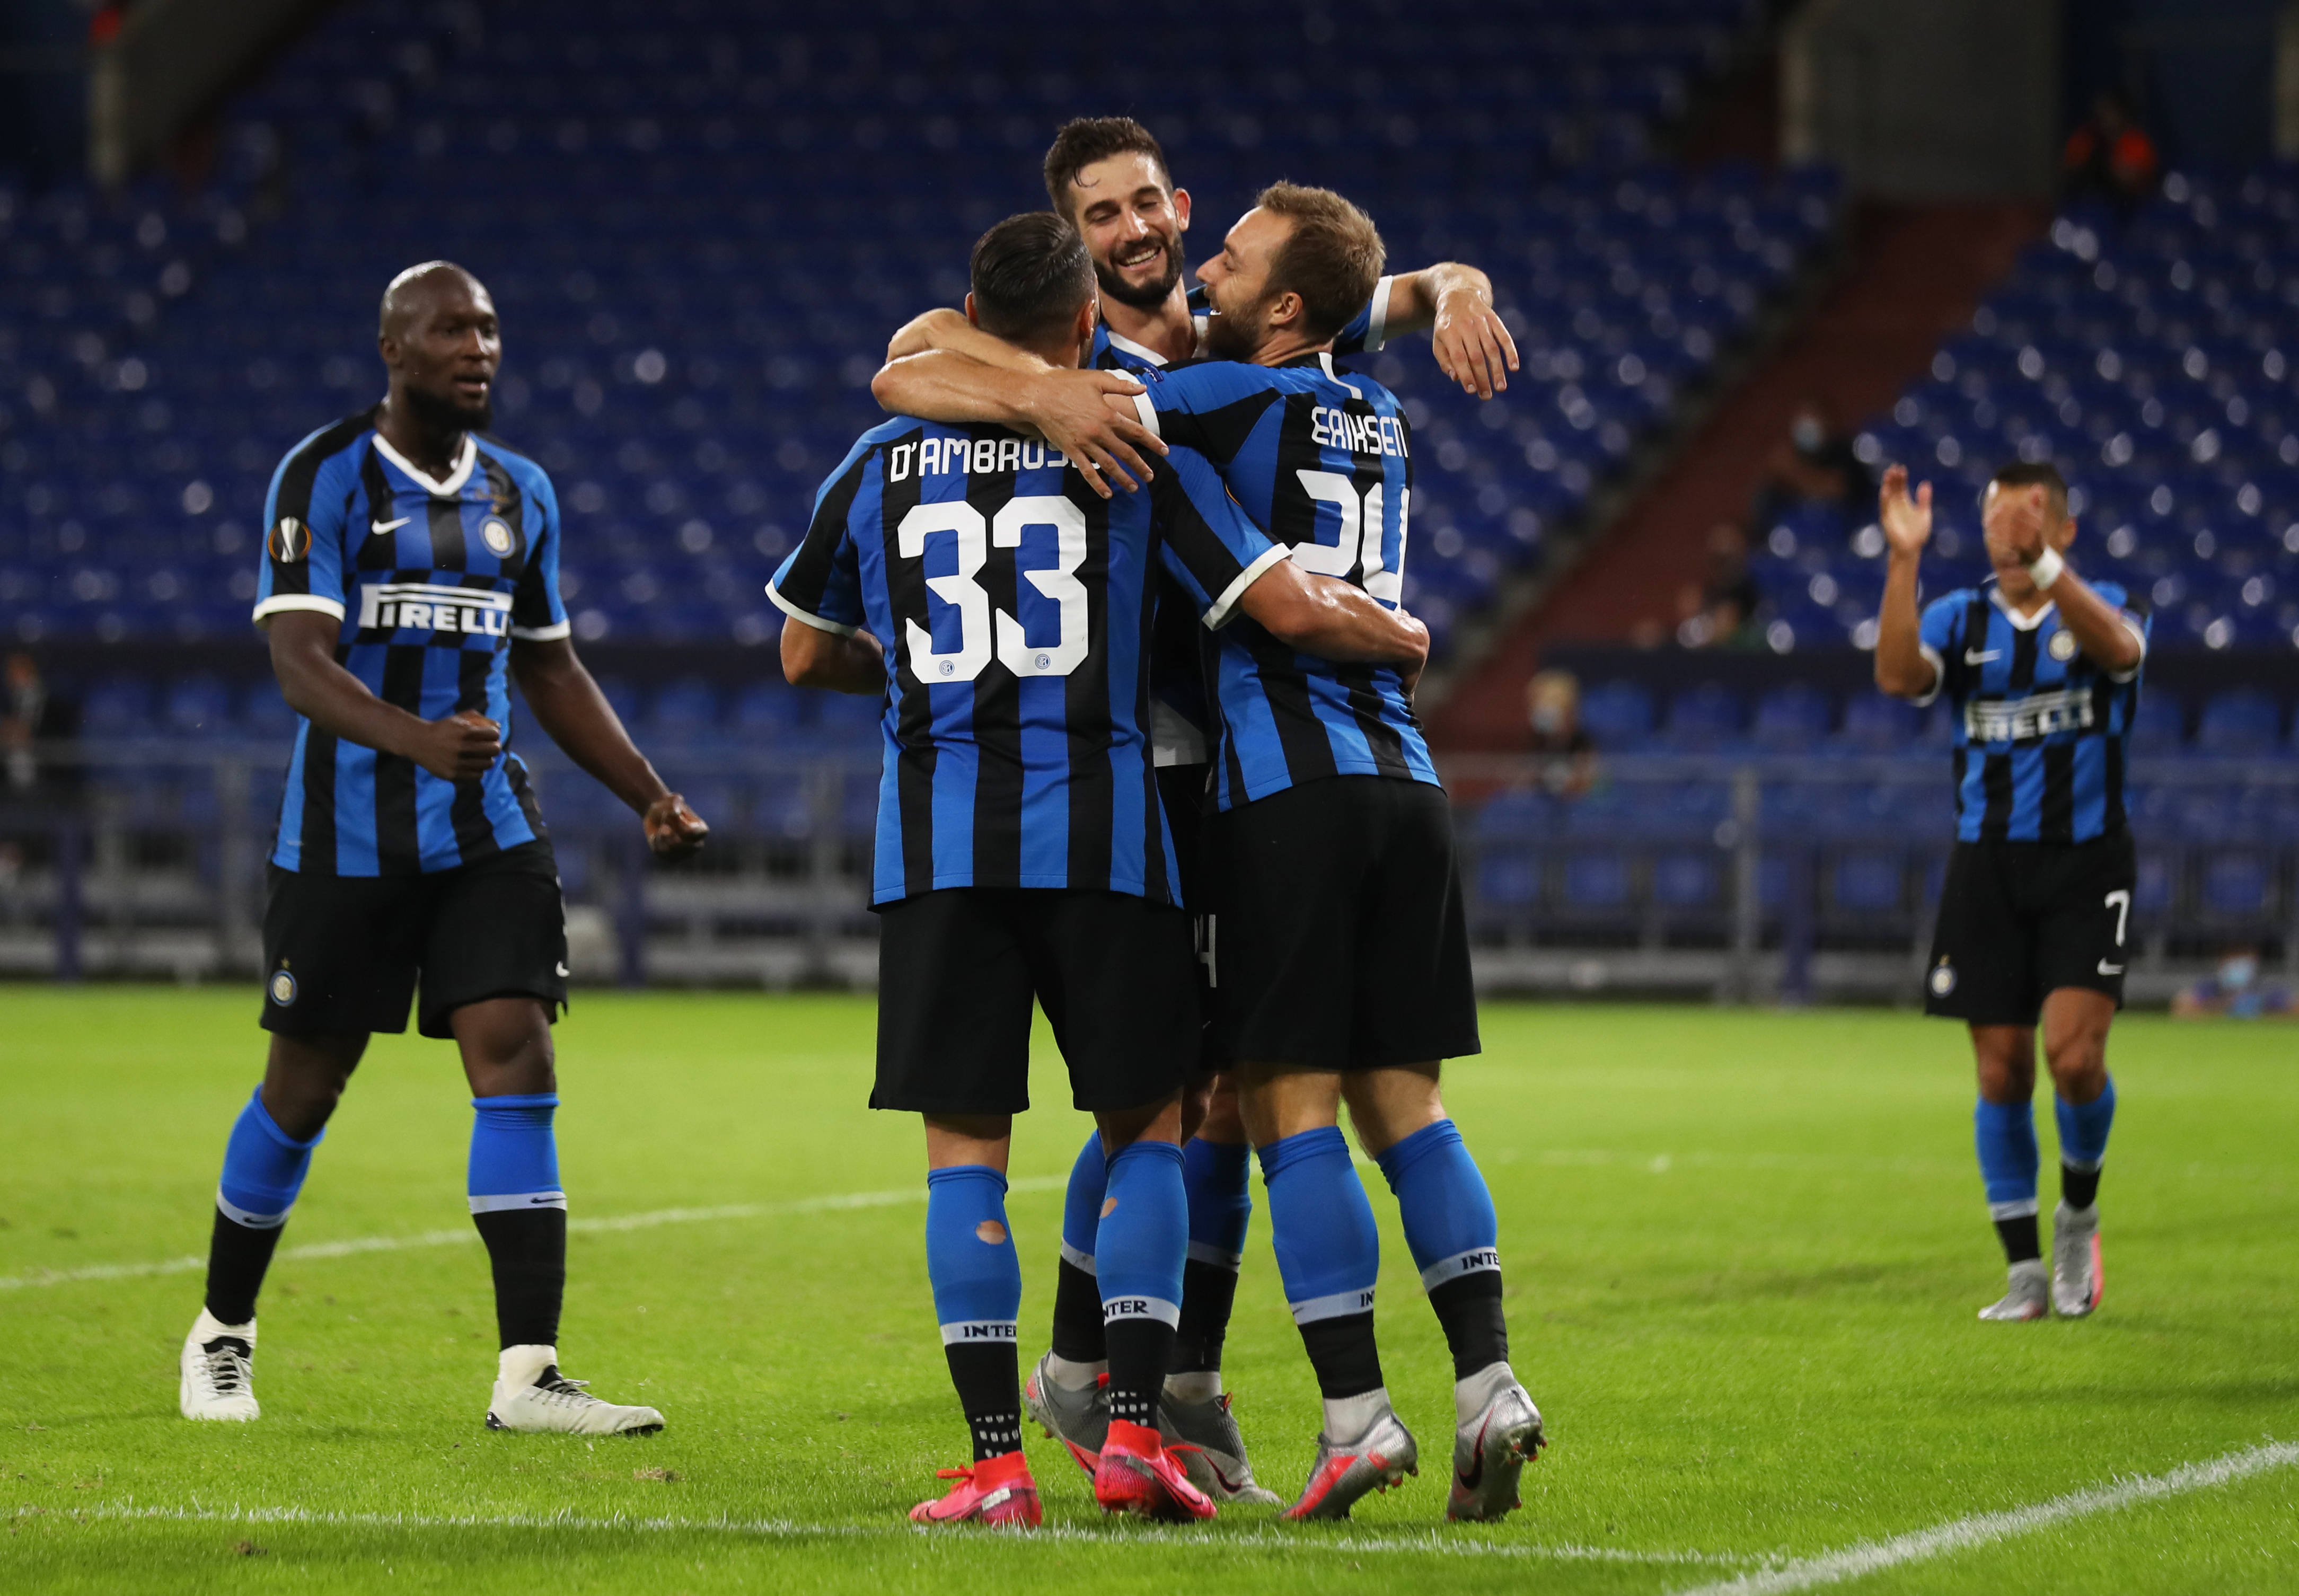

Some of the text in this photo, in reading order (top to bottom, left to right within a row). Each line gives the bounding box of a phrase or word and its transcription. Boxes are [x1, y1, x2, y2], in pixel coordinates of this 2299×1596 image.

[1311, 406, 1408, 458] ERIKSEN
[891, 437, 1101, 483] D'AMBROS
[897, 496, 1088, 684] 33
[2104, 889, 2130, 947] 7
[1194, 914, 1217, 988] 4
[1461, 1251, 1500, 1270] INTE
[963, 1325, 1017, 1337] INTE
[1103, 1300, 1149, 1318] NTER
